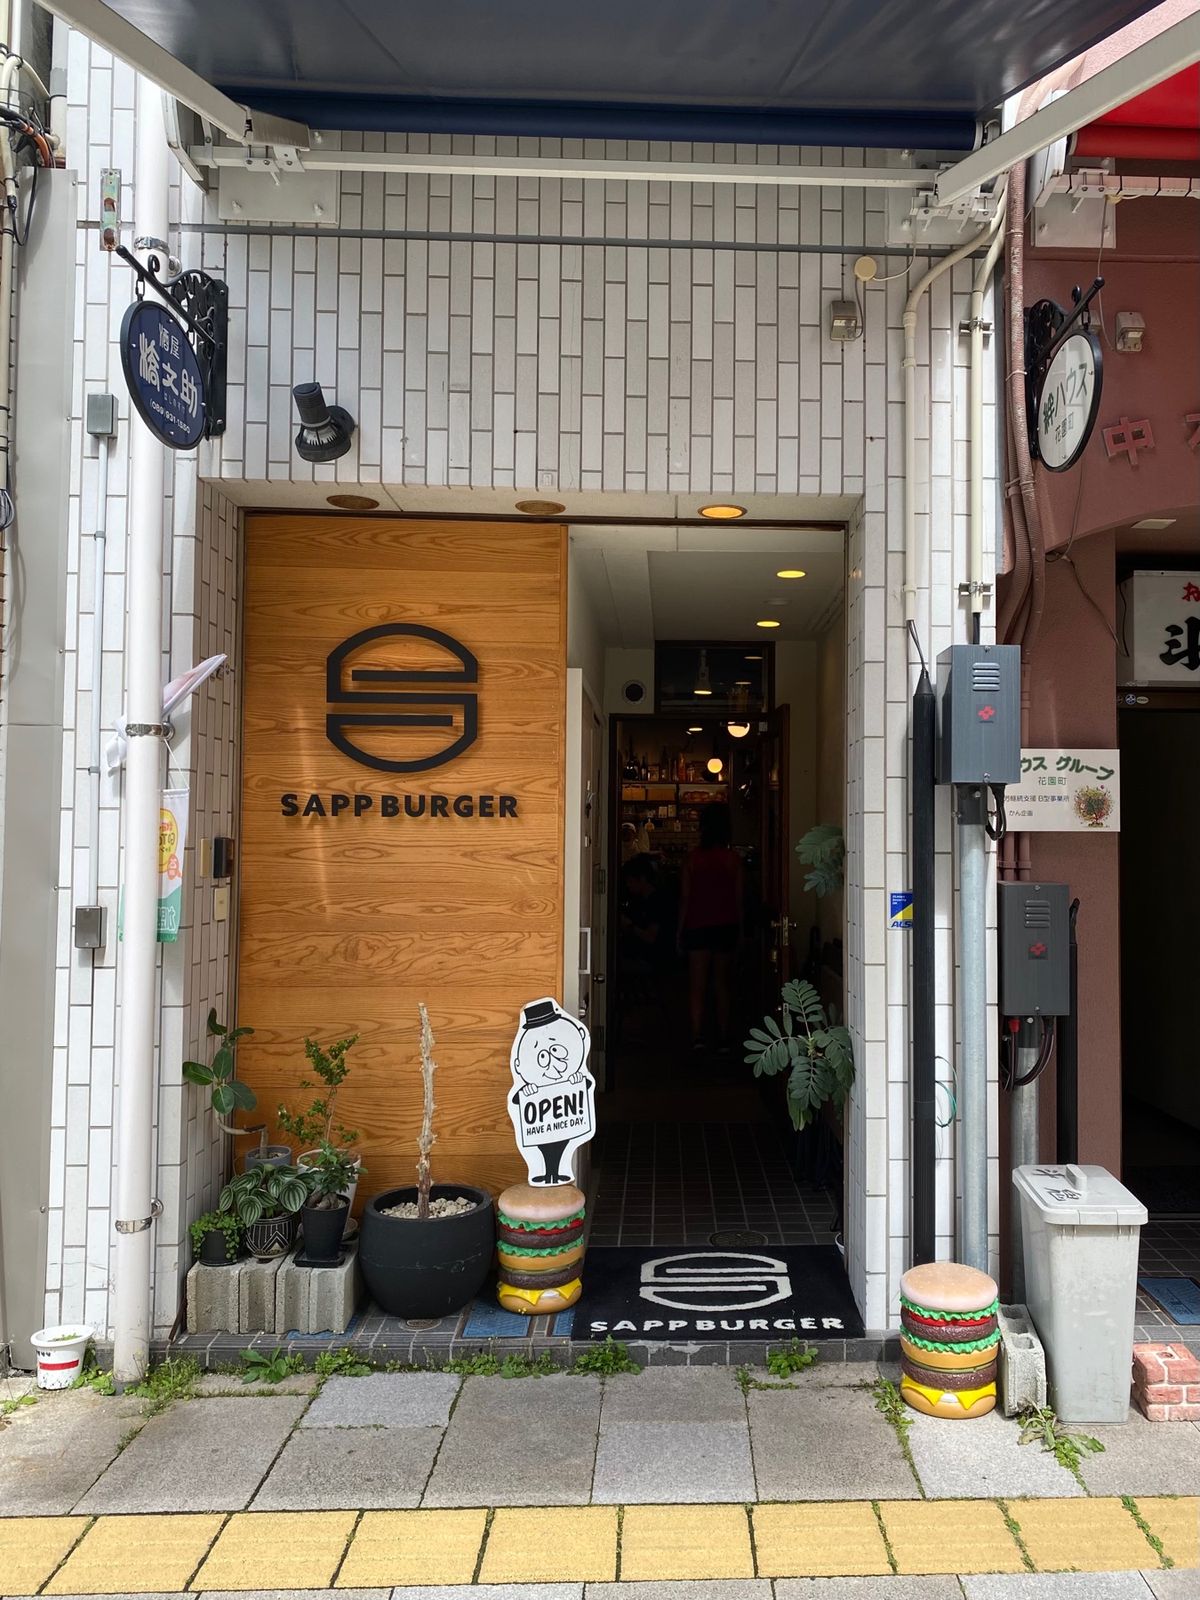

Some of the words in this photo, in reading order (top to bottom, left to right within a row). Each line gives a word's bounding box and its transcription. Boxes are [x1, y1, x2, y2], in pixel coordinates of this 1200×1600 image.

[1055, 755, 1115, 781] グループ
[1038, 776, 1067, 786] 花園町
[280, 794, 374, 817] SAPP
[381, 795, 519, 818] BURGER
[524, 1090, 584, 1125] OPEN!
[526, 1124, 545, 1136] HAVE
[546, 1123, 552, 1132] A
[553, 1119, 568, 1130] NICE
[569, 1117, 587, 1127] DAY.
[590, 1319, 688, 1332] SAPP
[695, 1317, 845, 1331] BURGER
